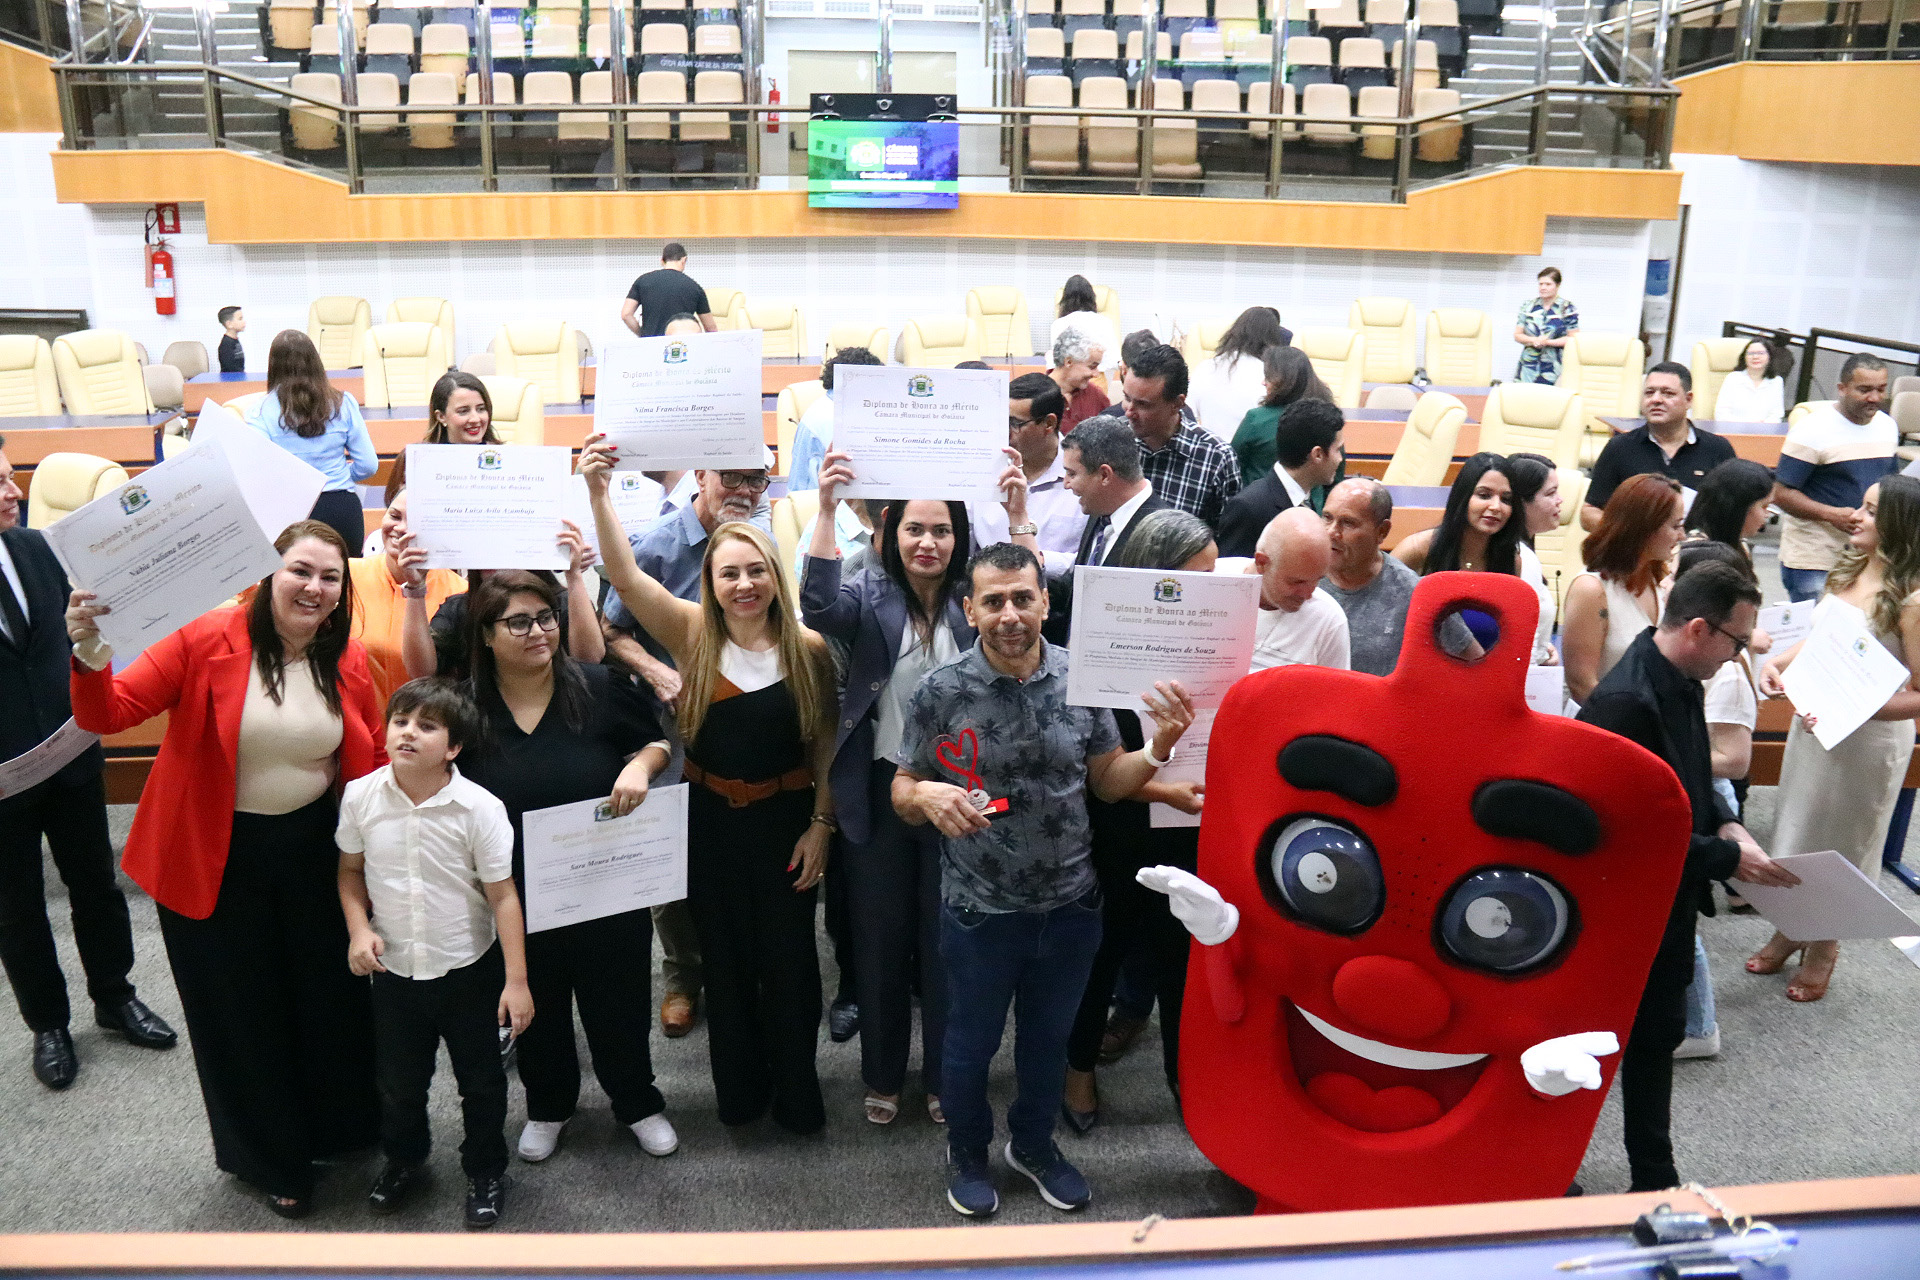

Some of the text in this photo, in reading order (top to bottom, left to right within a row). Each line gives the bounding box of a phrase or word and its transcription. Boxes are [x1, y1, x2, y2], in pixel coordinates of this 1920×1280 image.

[635, 404, 715, 413] Nilma Francisca Borges
[862, 399, 898, 409] Diploma
[899, 400, 908, 409] de
[911, 400, 937, 410] Honra
[951, 401, 979, 411] Mérito
[900, 411, 931, 419] Municipal
[873, 436, 966, 445] Simone Gomides da Rocha
[177, 531, 202, 551] Borges
[1104, 603, 1228, 617] Diploma de Honra ao Mérito
[1143, 616, 1177, 626] Municipal
[1109, 641, 1216, 654] Emerson Rodrigues de Souza
